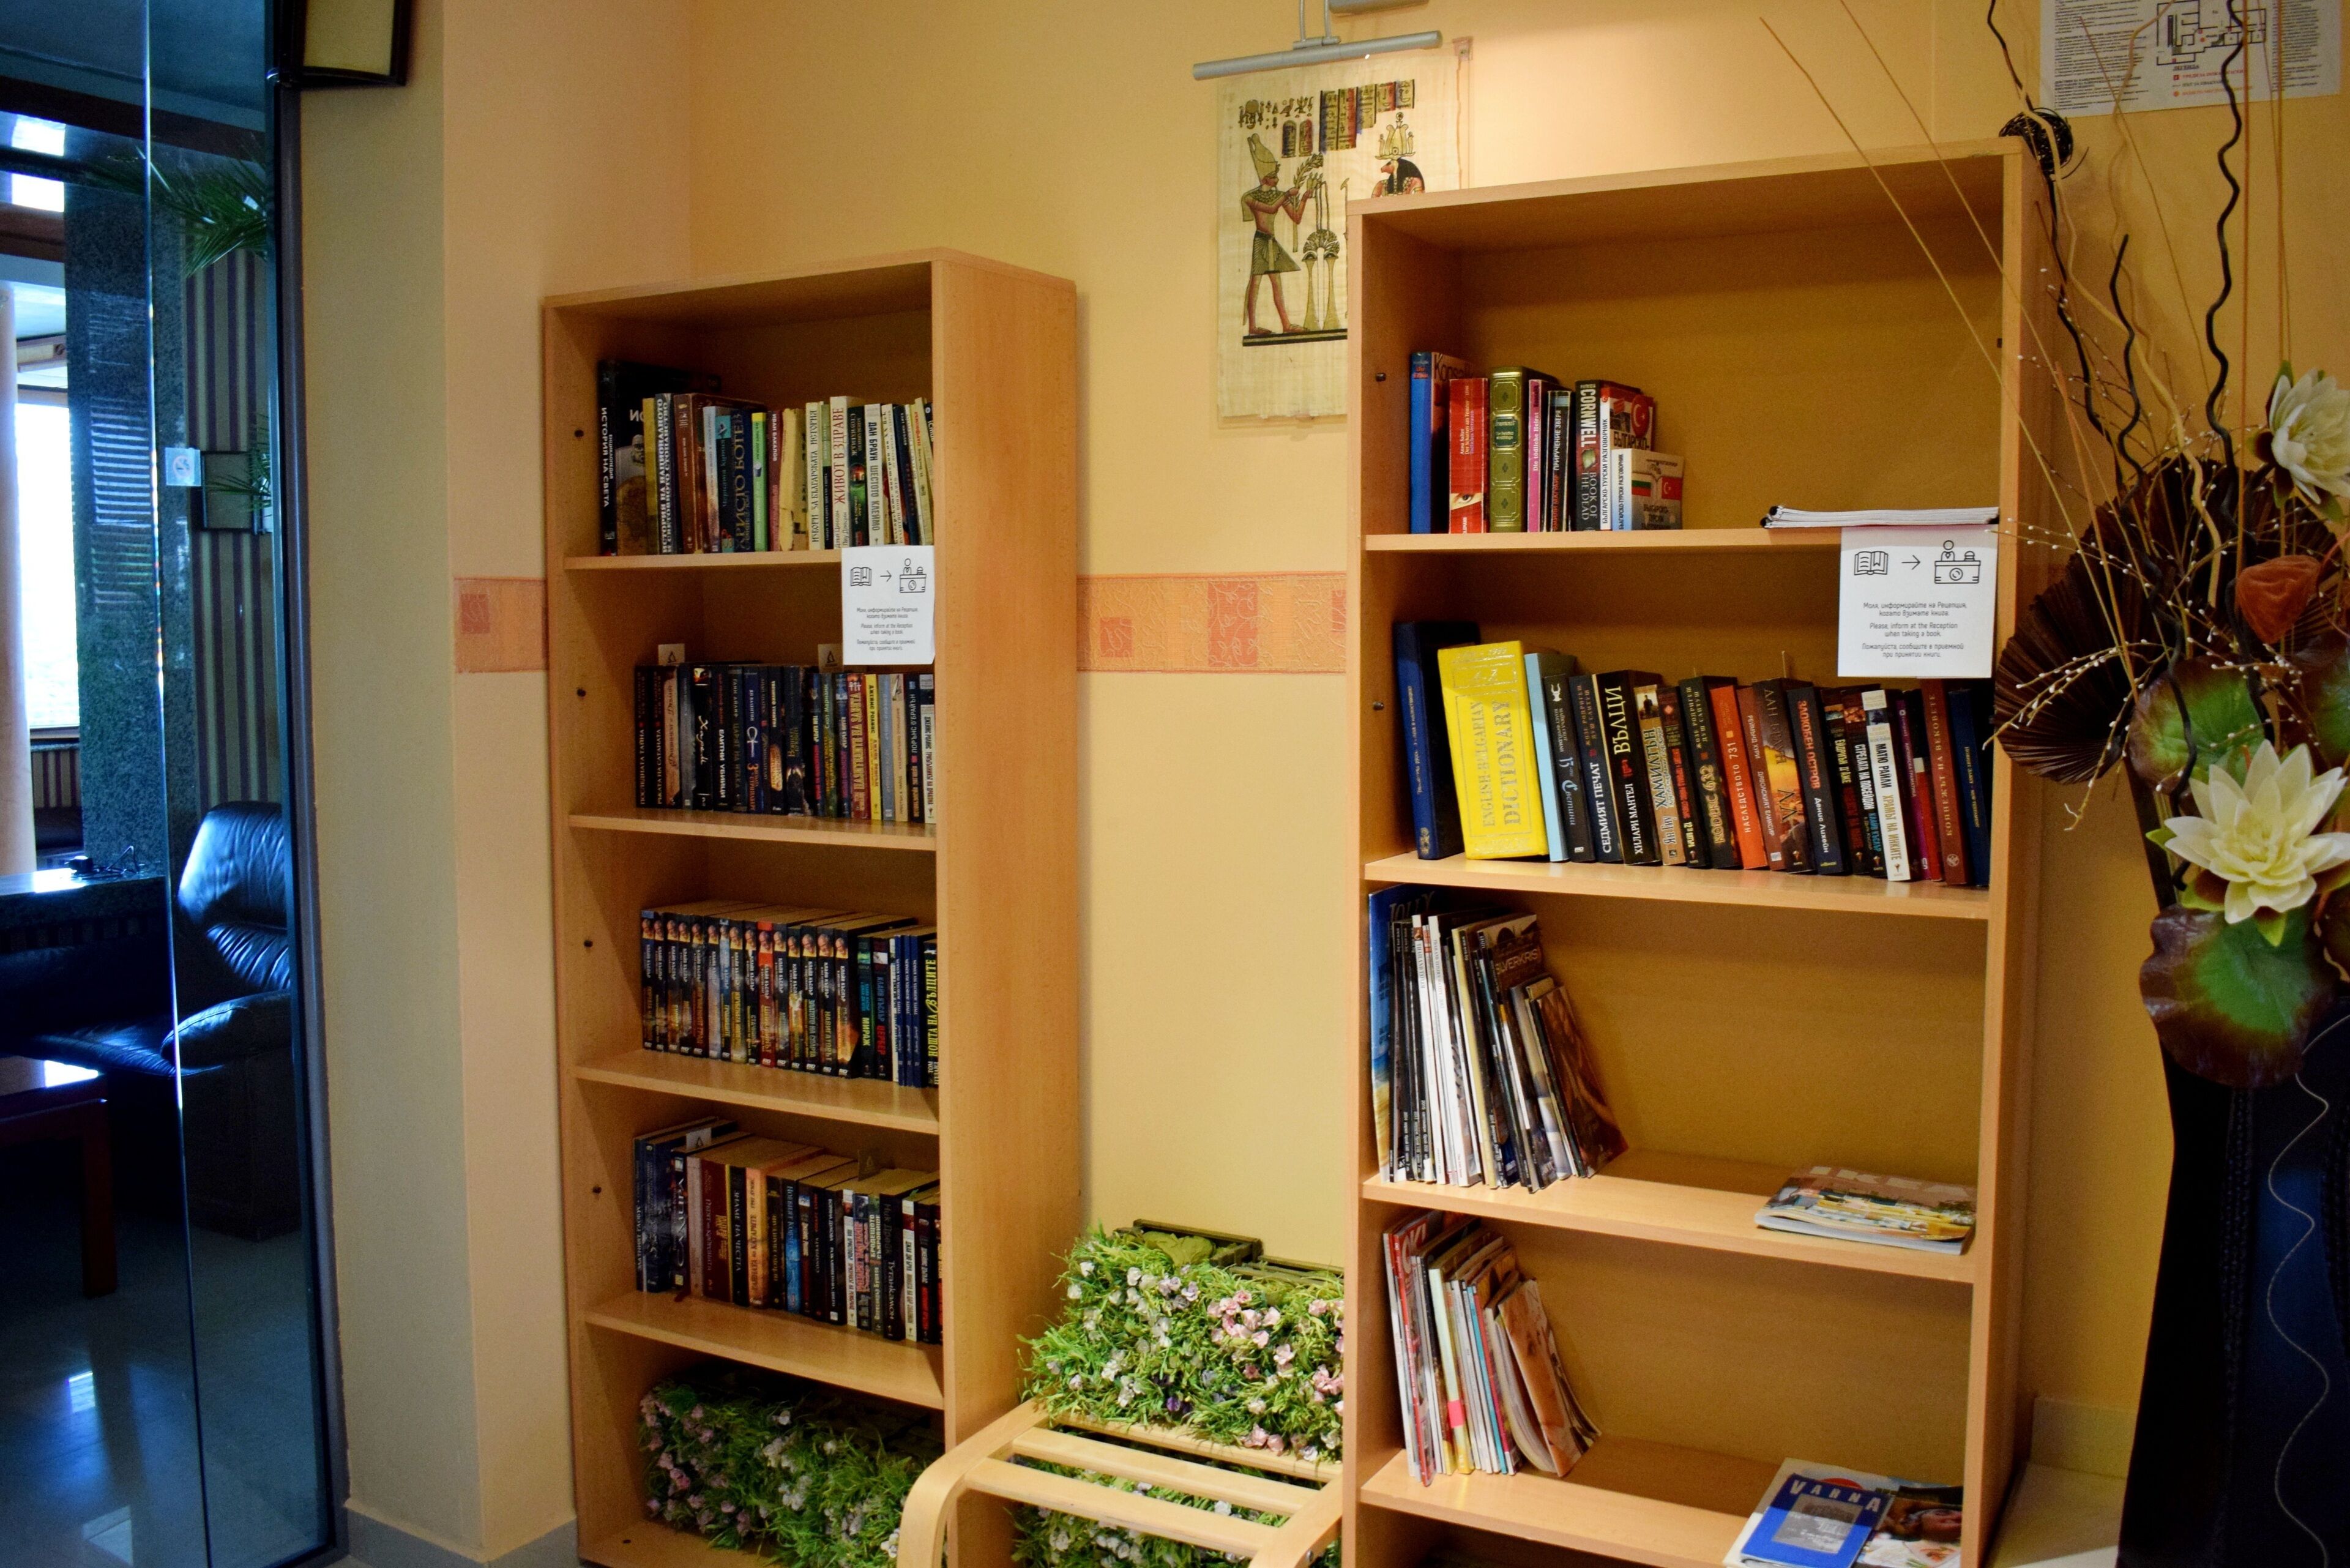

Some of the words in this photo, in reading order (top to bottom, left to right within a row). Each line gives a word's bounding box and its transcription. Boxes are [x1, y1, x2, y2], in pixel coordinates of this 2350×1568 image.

[833, 408, 846, 449] ЗДРАВЕ
[1580, 389, 1597, 447] CORNWELL
[657, 398, 666, 483] НАЦИОНАЛНОТО
[733, 413, 745, 470] БОТЕВ
[834, 450, 845, 459] В
[869, 439, 878, 461] БРАУН
[1553, 430, 1561, 471] ПРИРУЧЕНИЕ
[602, 458, 608, 471] НА
[660, 487, 666, 500] НА
[834, 463, 845, 504] ЖИВОТ
[870, 466, 878, 497] ШЕСТОТО
[1589, 472, 1597, 501] BOOK
[734, 474, 747, 550] ХРИСТО
[871, 501, 880, 531] КЛЕЙМО
[1581, 493, 1591, 520] DEAD
[1589, 506, 1597, 518] OF
[1685, 687, 1698, 726] РОДРИГЕШ
[1694, 691, 1706, 722] САНТУШ
[1763, 688, 1778, 717] ДАН
[852, 724, 862, 735] НА
[1605, 685, 1631, 754] ВЪЛЦИ
[1928, 693, 1942, 750] ВЕКОВЕТЕ
[696, 715, 708, 765] Харем
[1726, 742, 1740, 759] 731
[1747, 715, 1757, 743] РЕЙМЪНД
[1752, 744, 1761, 759] ХУРИ
[1769, 723, 1788, 764] БРАУН
[1797, 700, 1815, 750] ЗЛОКОБЕН
[1806, 752, 1821, 790] ОСТРОВ
[733, 751, 739, 761] НА
[1470, 701, 1496, 827] ENGLISH-BULGARIAN
[1492, 700, 1521, 825] DICTIONARY
[1643, 729, 1668, 808] ХАМИЛТЪН
[1854, 744, 1868, 771] СТРЕЛАТА
[1875, 744, 1887, 764] МАТЮ
[1936, 755, 1945, 770] НА
[657, 767, 662, 777] НА
[1590, 761, 1603, 797] ПЕЧАТ
[1699, 764, 1716, 791] 632
[1878, 766, 1892, 788] РАЙЛИ
[1908, 771, 1917, 797] ГРАМАТИКА
[1625, 783, 1639, 818] МАНТЕЛ
[1733, 763, 1751, 833] НАСЛЕДСТВОТО
[1757, 771, 1769, 809] ДЯВОЛСКИЯТ
[1764, 810, 1775, 836] ЕЛИКСИР
[1860, 781, 1874, 810] ПОСЕЙДОН
[1882, 794, 1897, 821] ХРАМЪТ
[1939, 775, 1953, 835] КОПНЕЖЪТ
[1595, 801, 1612, 853] СЕДМИЯТ
[1706, 793, 1726, 843] КОДЕКС
[1814, 797, 1822, 822] Денис
[1818, 823, 1829, 853] Лихейн
[1886, 823, 1897, 832] НА
[1630, 819, 1643, 854] ХИЛАРИ
[1665, 832, 1676, 844] Ян
[1889, 834, 1902, 861] ИНКИТЕ
[924, 959, 938, 1012] ВЪЛЦИТЕ
[861, 1017, 870, 1046] МИРАЖ
[927, 1014, 938, 1024] НА
[876, 1025, 886, 1056] ЦЕРБЕР
[927, 1028, 938, 1056] НОЩТА
[734, 1224, 741, 1236] НА
[887, 1261, 896, 1320] Тутанкамон
[1790, 1479, 1882, 1513] VARNA
